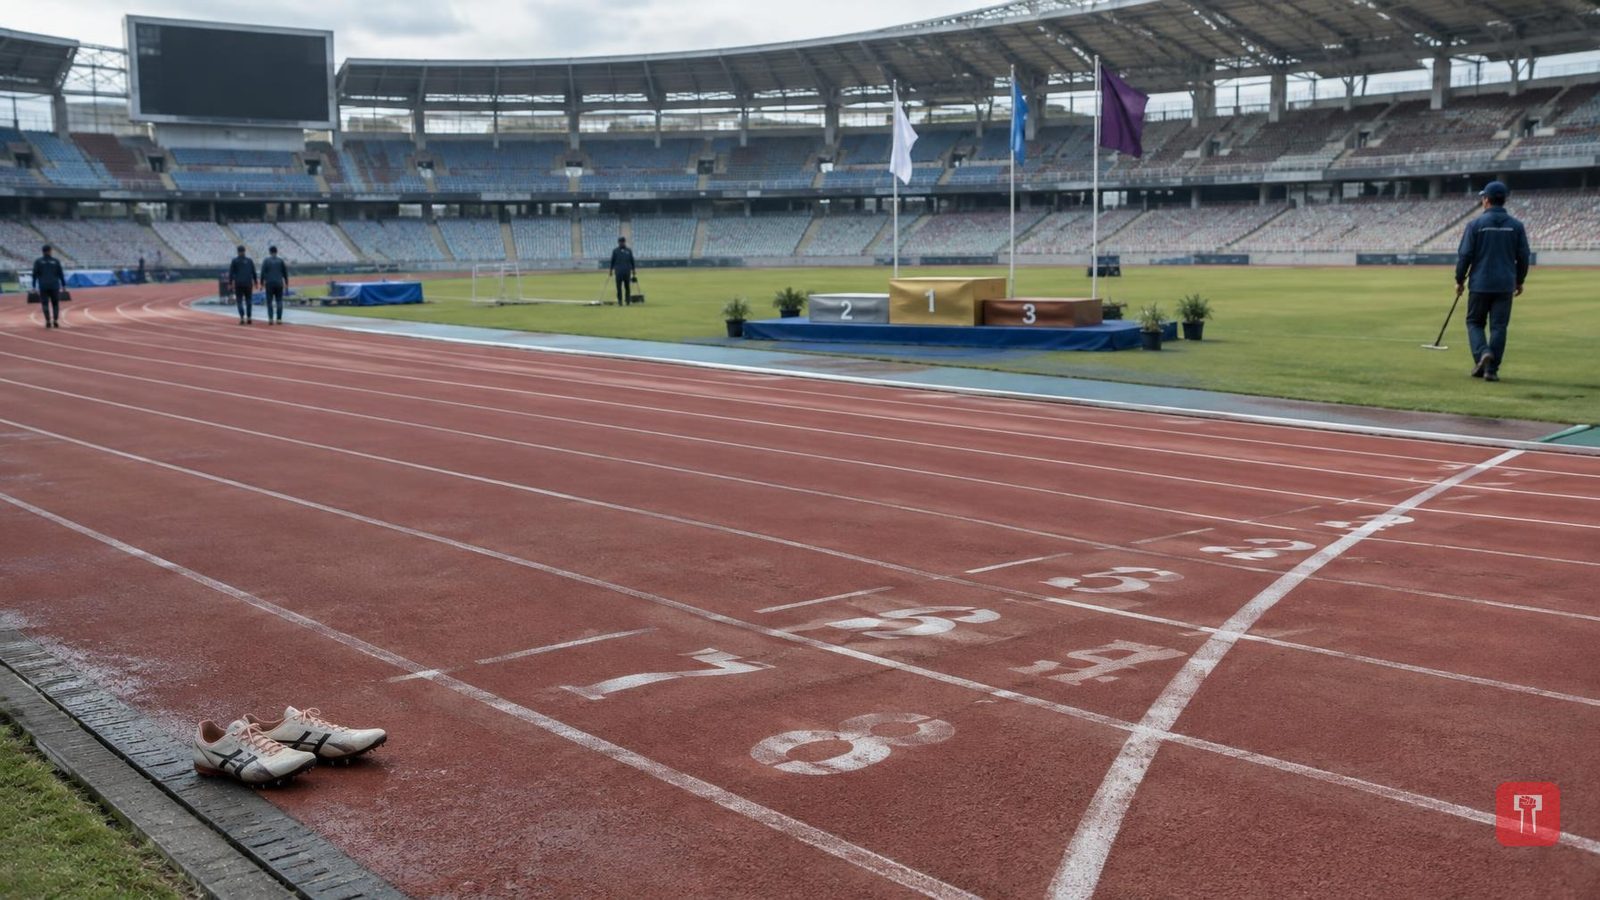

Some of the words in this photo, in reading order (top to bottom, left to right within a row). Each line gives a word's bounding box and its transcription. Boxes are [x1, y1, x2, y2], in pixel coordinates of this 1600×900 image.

[839, 299, 854, 320] 2
[924, 288, 936, 313] 1
[1021, 302, 1037, 325] 3
[559, 647, 776, 700] 7
[749, 711, 956, 775] 8
